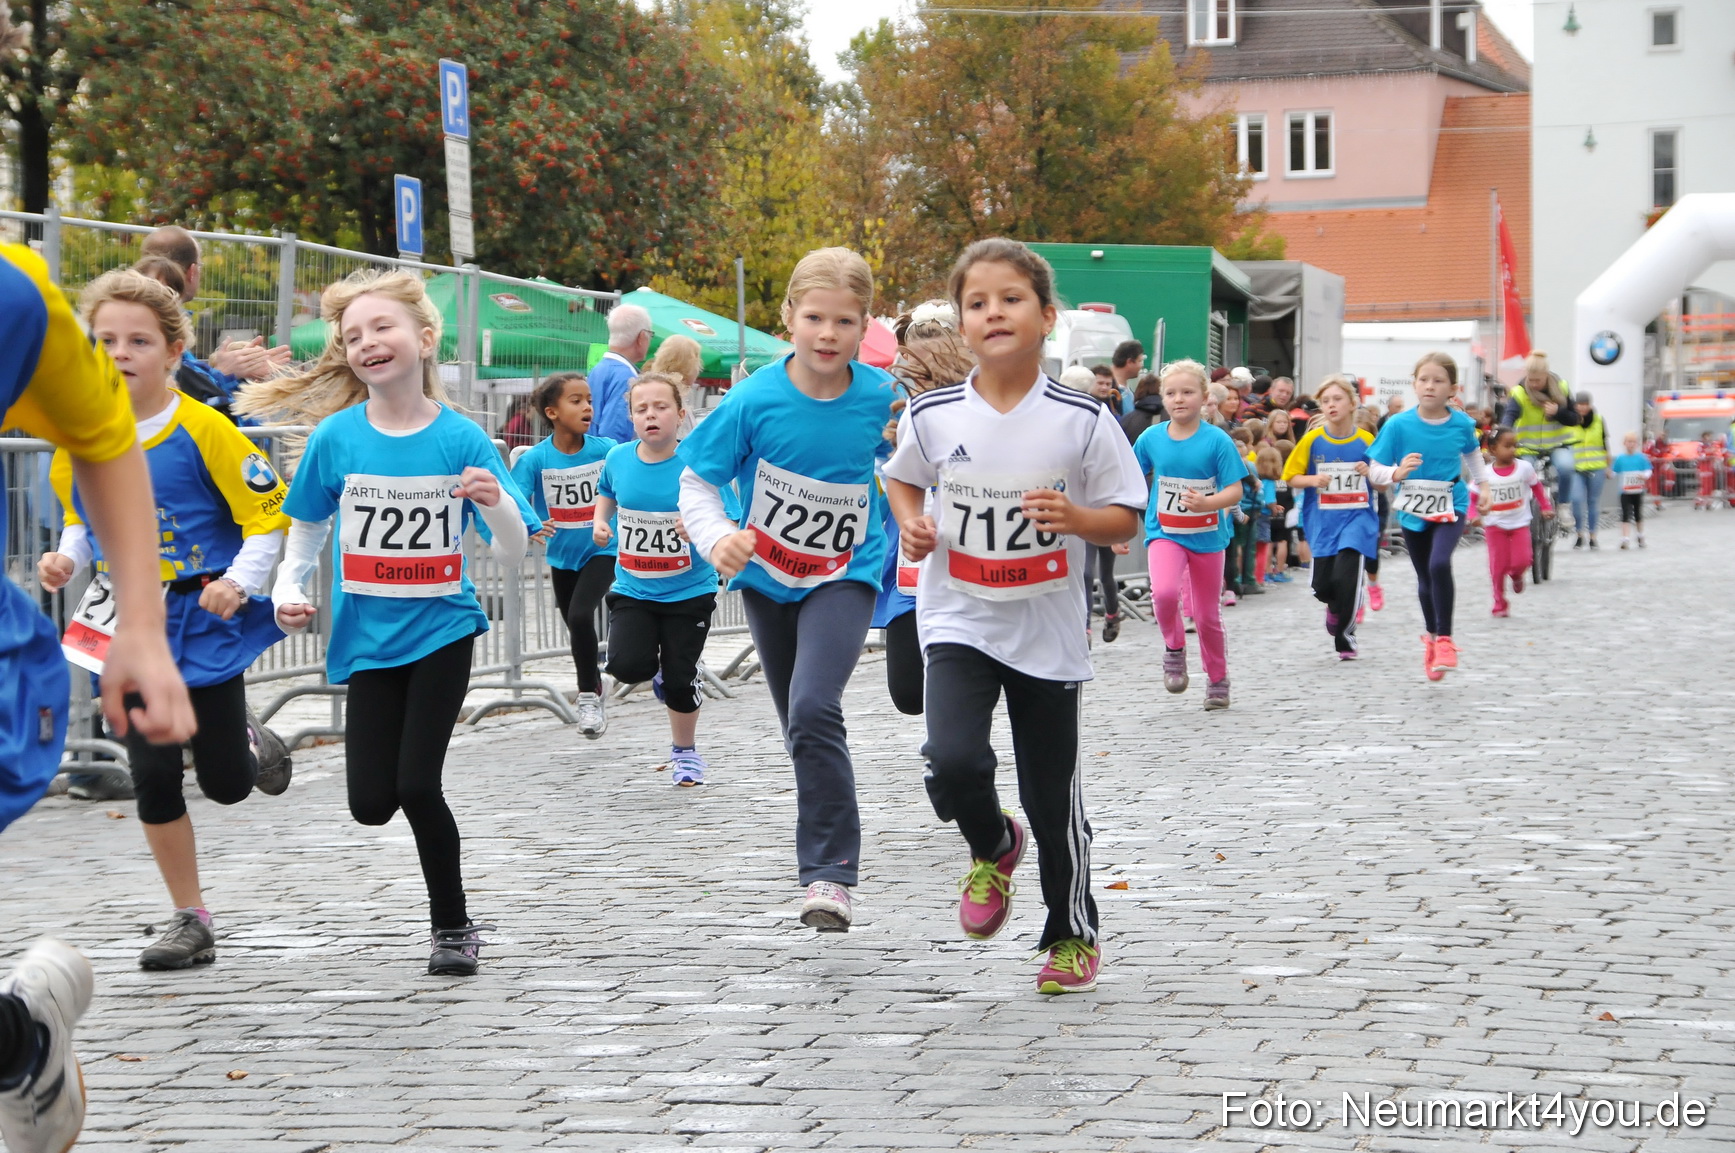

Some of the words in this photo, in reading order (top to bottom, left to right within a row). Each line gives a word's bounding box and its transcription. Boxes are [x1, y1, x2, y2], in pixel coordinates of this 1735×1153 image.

[446, 70, 461, 125] P
[401, 186, 417, 243] P
[566, 469, 598, 480] Neumarkt
[345, 486, 384, 499] PARTL
[387, 488, 445, 500] Neumarkt
[758, 469, 795, 496] PARTL
[798, 487, 854, 507] Neumarkt
[944, 480, 979, 498] PARTL
[1160, 481, 1181, 490] PARTL
[1491, 485, 1522, 502] 7501
[1402, 493, 1447, 514] 7220
[354, 505, 450, 550] 7221
[637, 517, 673, 526] Neumarkt
[763, 489, 858, 553] 7226
[622, 525, 682, 554] 7243
[375, 562, 435, 580] Carolin
[634, 559, 669, 569] Nadine
[980, 564, 1028, 583] Luisa
